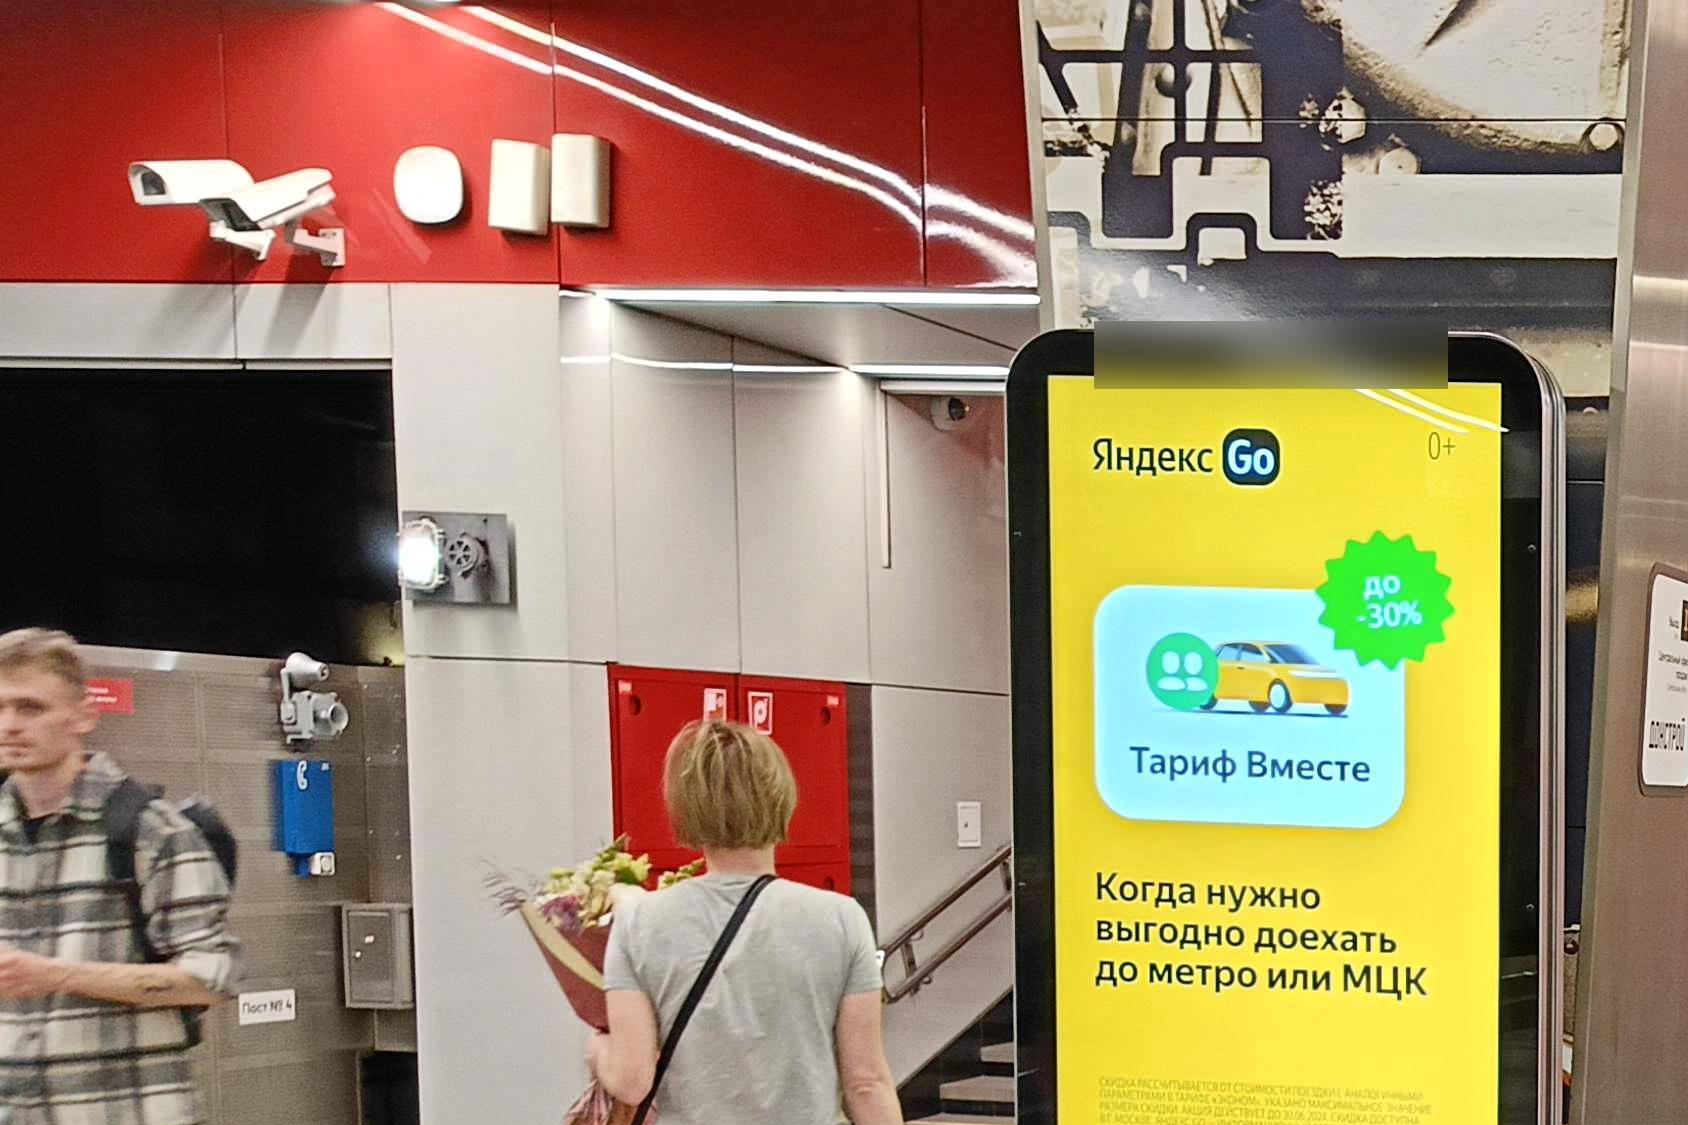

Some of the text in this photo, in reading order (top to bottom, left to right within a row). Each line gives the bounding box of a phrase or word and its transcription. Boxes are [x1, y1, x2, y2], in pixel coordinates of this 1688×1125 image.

[1093, 439, 1275, 476] Яндекс Go
[1427, 431, 1456, 461] 0+
[1363, 576, 1401, 599] до
[1356, 602, 1422, 628] -30%
[1130, 746, 1371, 782] Тариф Вместе
[1096, 871, 1321, 913] Когда нужно
[1096, 919, 1397, 954] выгодно доехать
[1095, 960, 1428, 1000] до метро или МЦК
[242, 1001, 268, 1015] Пост
[285, 998, 292, 1011] 4
